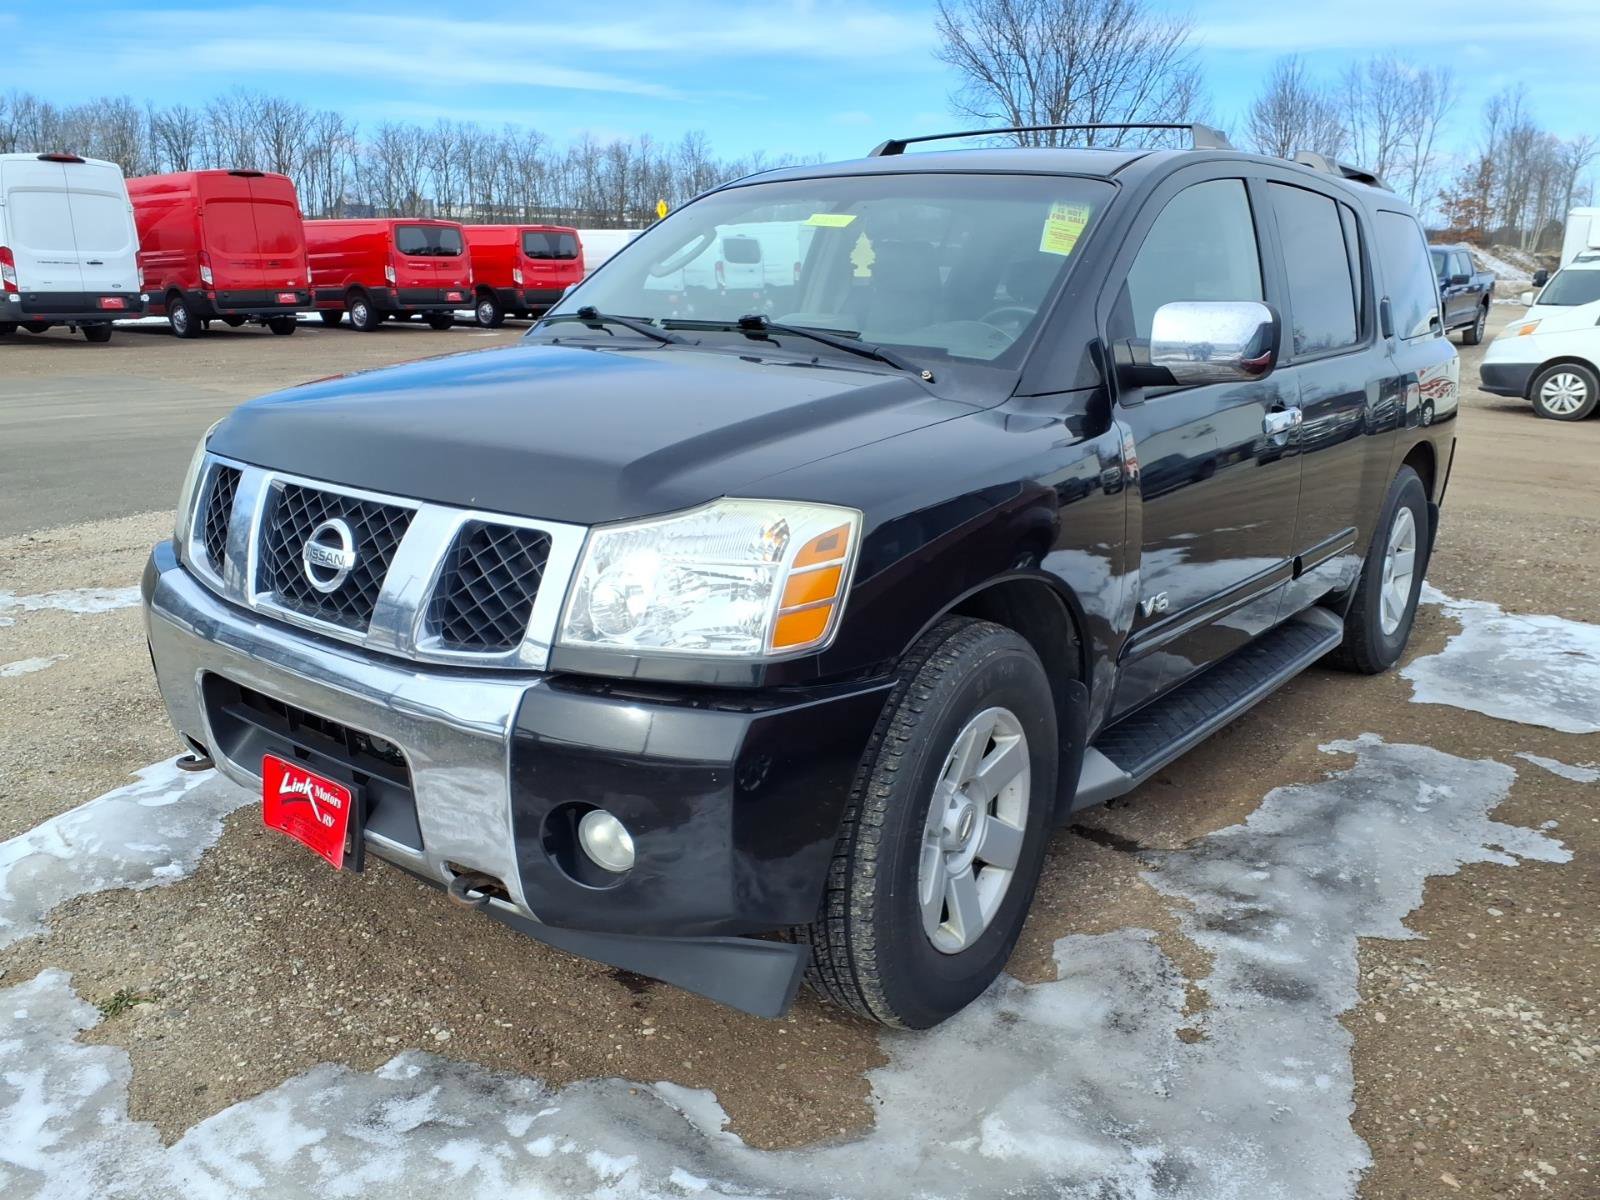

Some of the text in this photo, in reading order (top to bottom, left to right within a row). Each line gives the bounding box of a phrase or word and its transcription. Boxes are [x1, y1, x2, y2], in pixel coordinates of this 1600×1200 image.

[1067, 216, 1085, 224] SALE
[305, 544, 345, 566] NISSAN
[315, 785, 342, 809] Motors
[323, 813, 336, 828] RV
